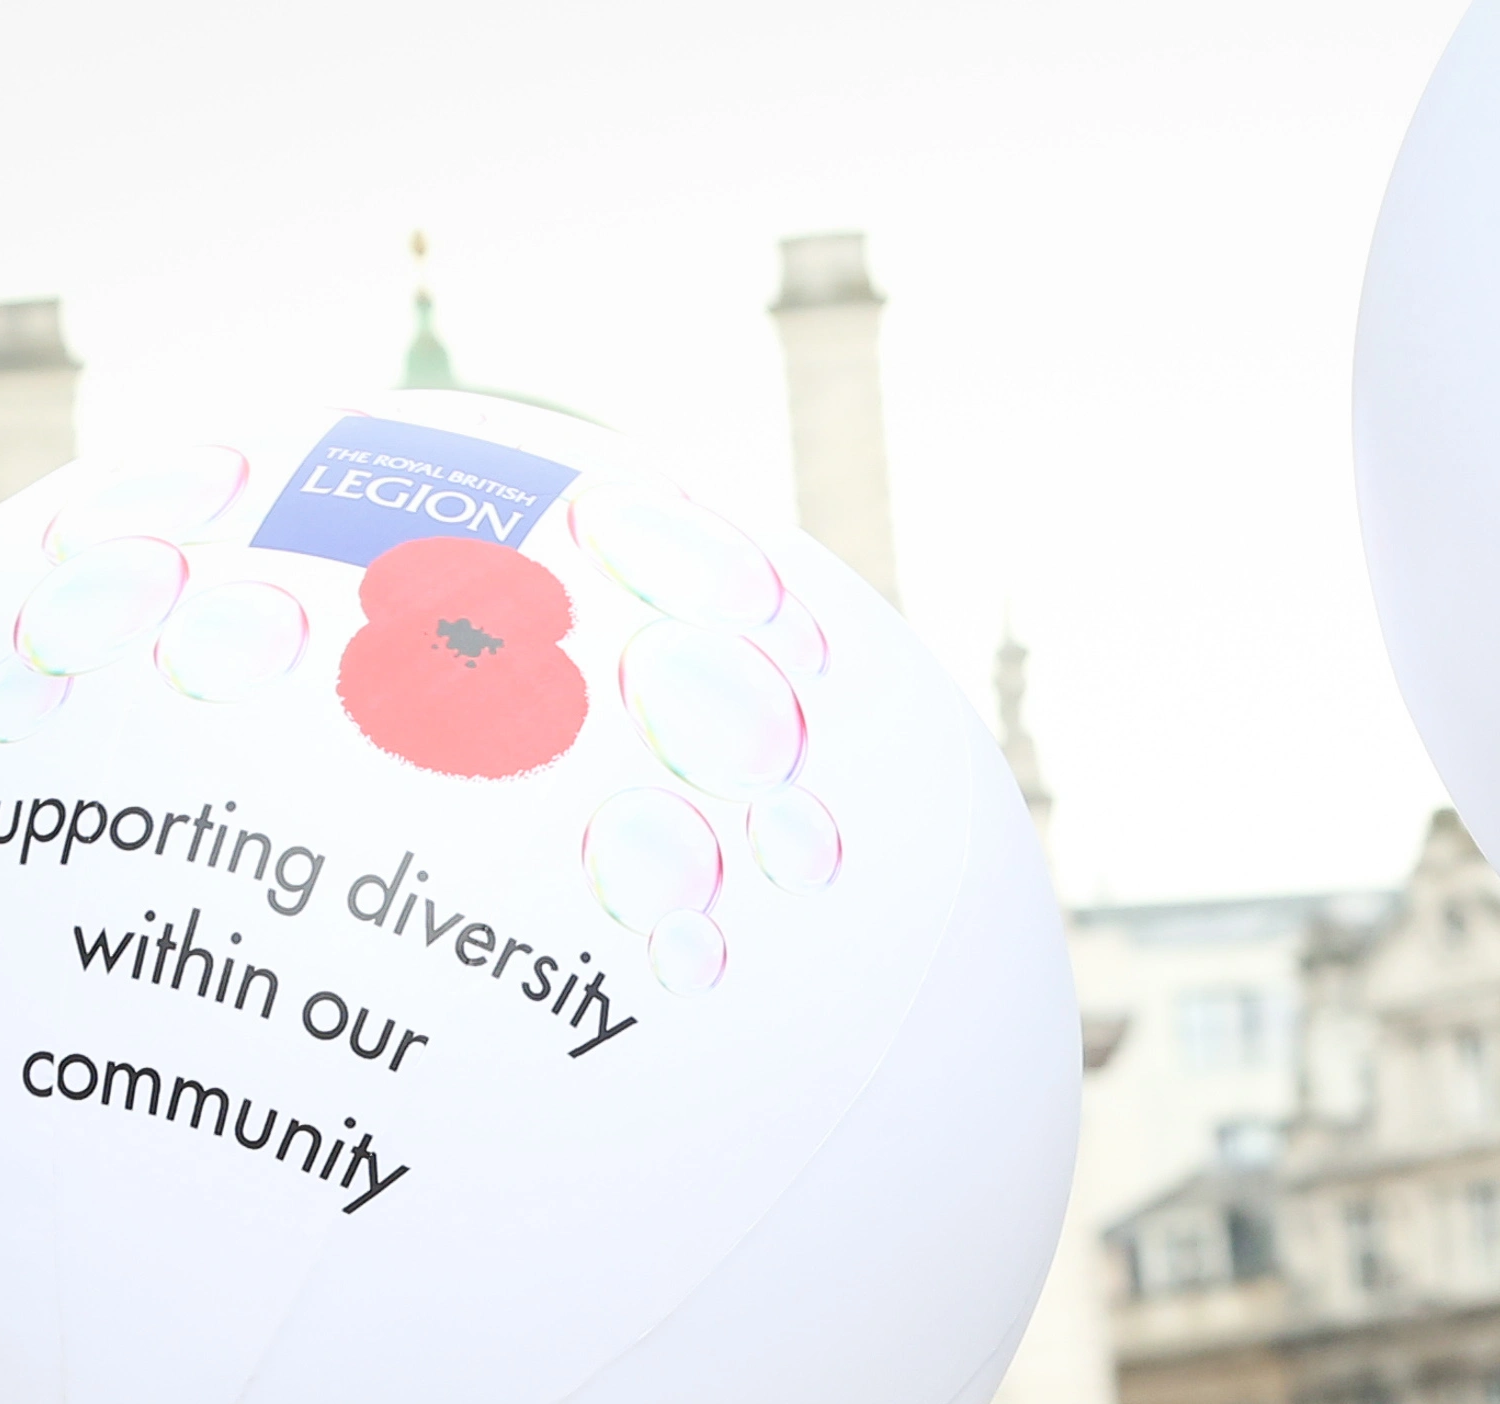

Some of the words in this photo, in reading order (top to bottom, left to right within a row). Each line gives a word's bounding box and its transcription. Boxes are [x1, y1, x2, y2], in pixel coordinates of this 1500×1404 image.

[299, 464, 525, 543] LEGION
[325, 446, 372, 465] THE
[372, 454, 444, 480] ROYAL
[446, 470, 539, 508] BRITISH
[73, 908, 279, 1020] within
[301, 990, 430, 1073] our
[347, 851, 639, 1060] diversity
[22, 1050, 411, 1215] community
